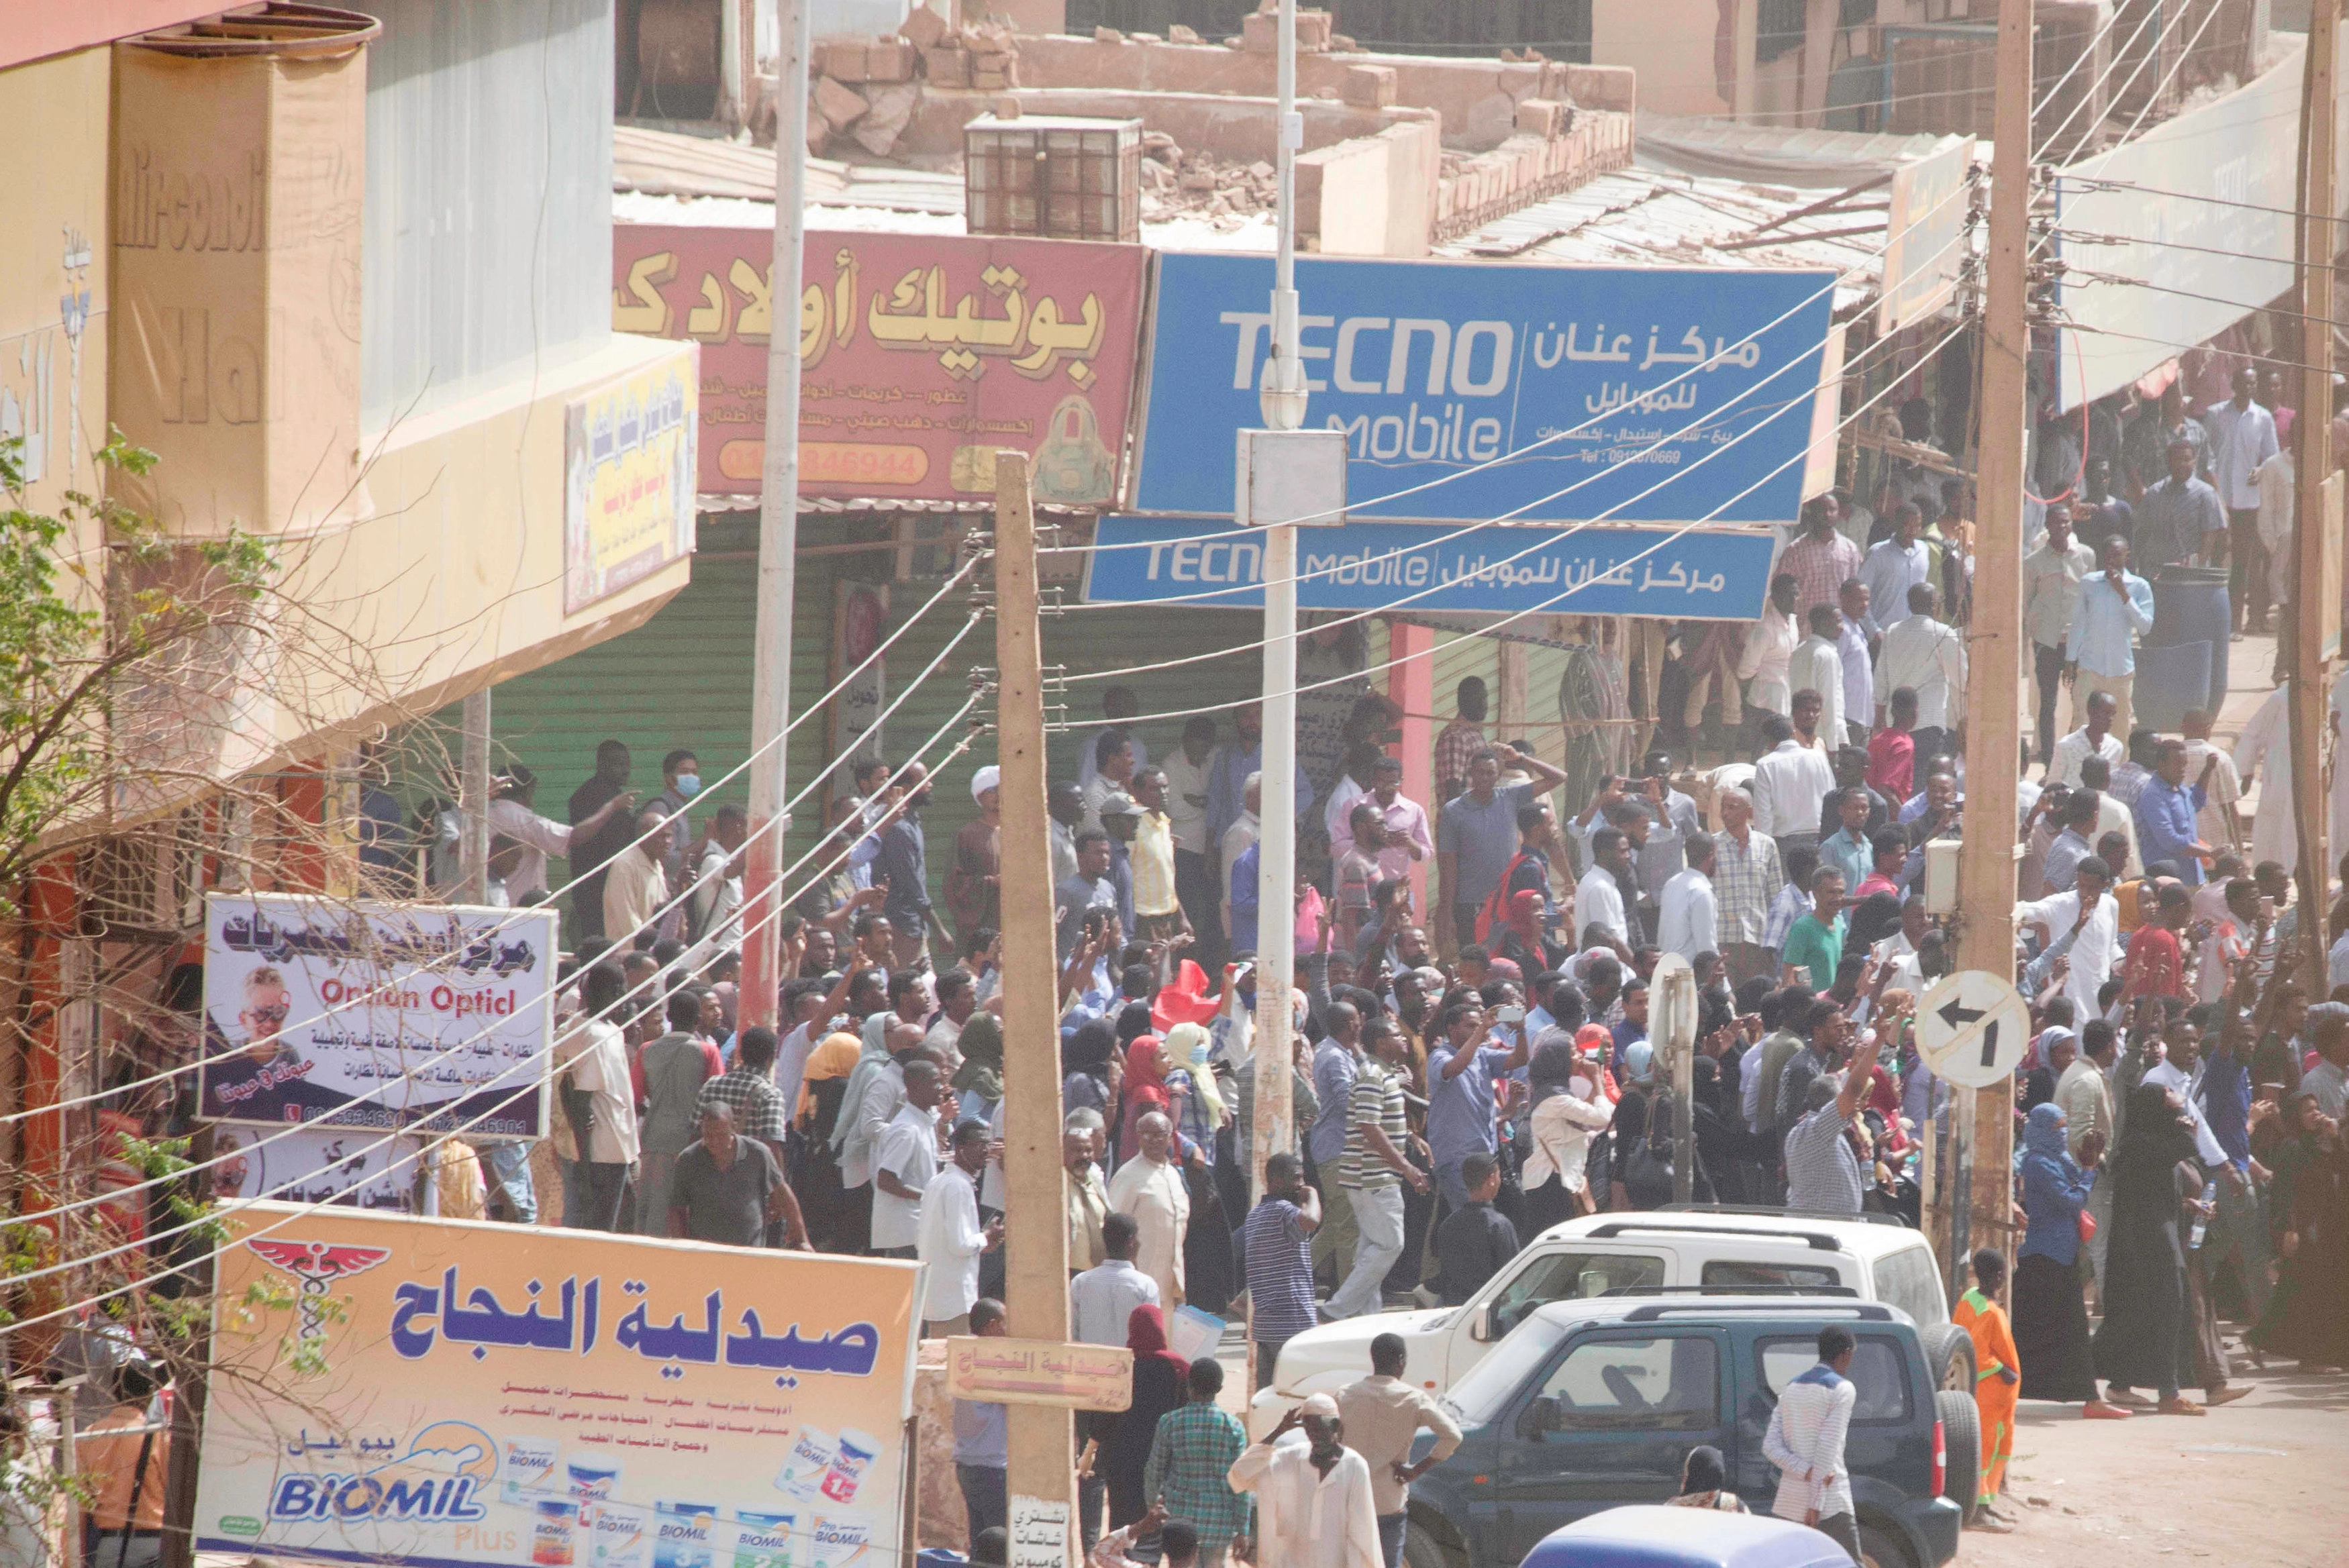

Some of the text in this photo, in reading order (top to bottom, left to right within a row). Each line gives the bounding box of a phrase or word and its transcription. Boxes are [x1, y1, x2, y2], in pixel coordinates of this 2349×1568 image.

[868, 264, 1105, 389] بوتيك
[1219, 311, 1514, 396] TECNO
[1534, 322, 1760, 372] مركز عنان
[847, 384, 903, 404] كريمات
[926, 388, 968, 406] عطور
[1586, 382, 1697, 415] للموبايل
[704, 407, 753, 425] أطفال
[846, 413, 890, 434] صيني
[1711, 429, 1733, 444] بيع
[1441, 554, 1726, 594] مركز عنان للموبايل
[321, 978, 515, 1017] Option Opticl
[389, 1265, 880, 1390] صيدلية النجاح
[274, 1477, 479, 1517] BIOMIL
[1014, 1508, 1066, 1528] نشتري
[454, 1524, 518, 1553] Plus
[659, 1524, 707, 1541] BIOMIL
[739, 1533, 785, 1548] BIOMIL
[815, 1531, 863, 1545] BIOMIL
[1015, 1530, 1062, 1547] شاشات
